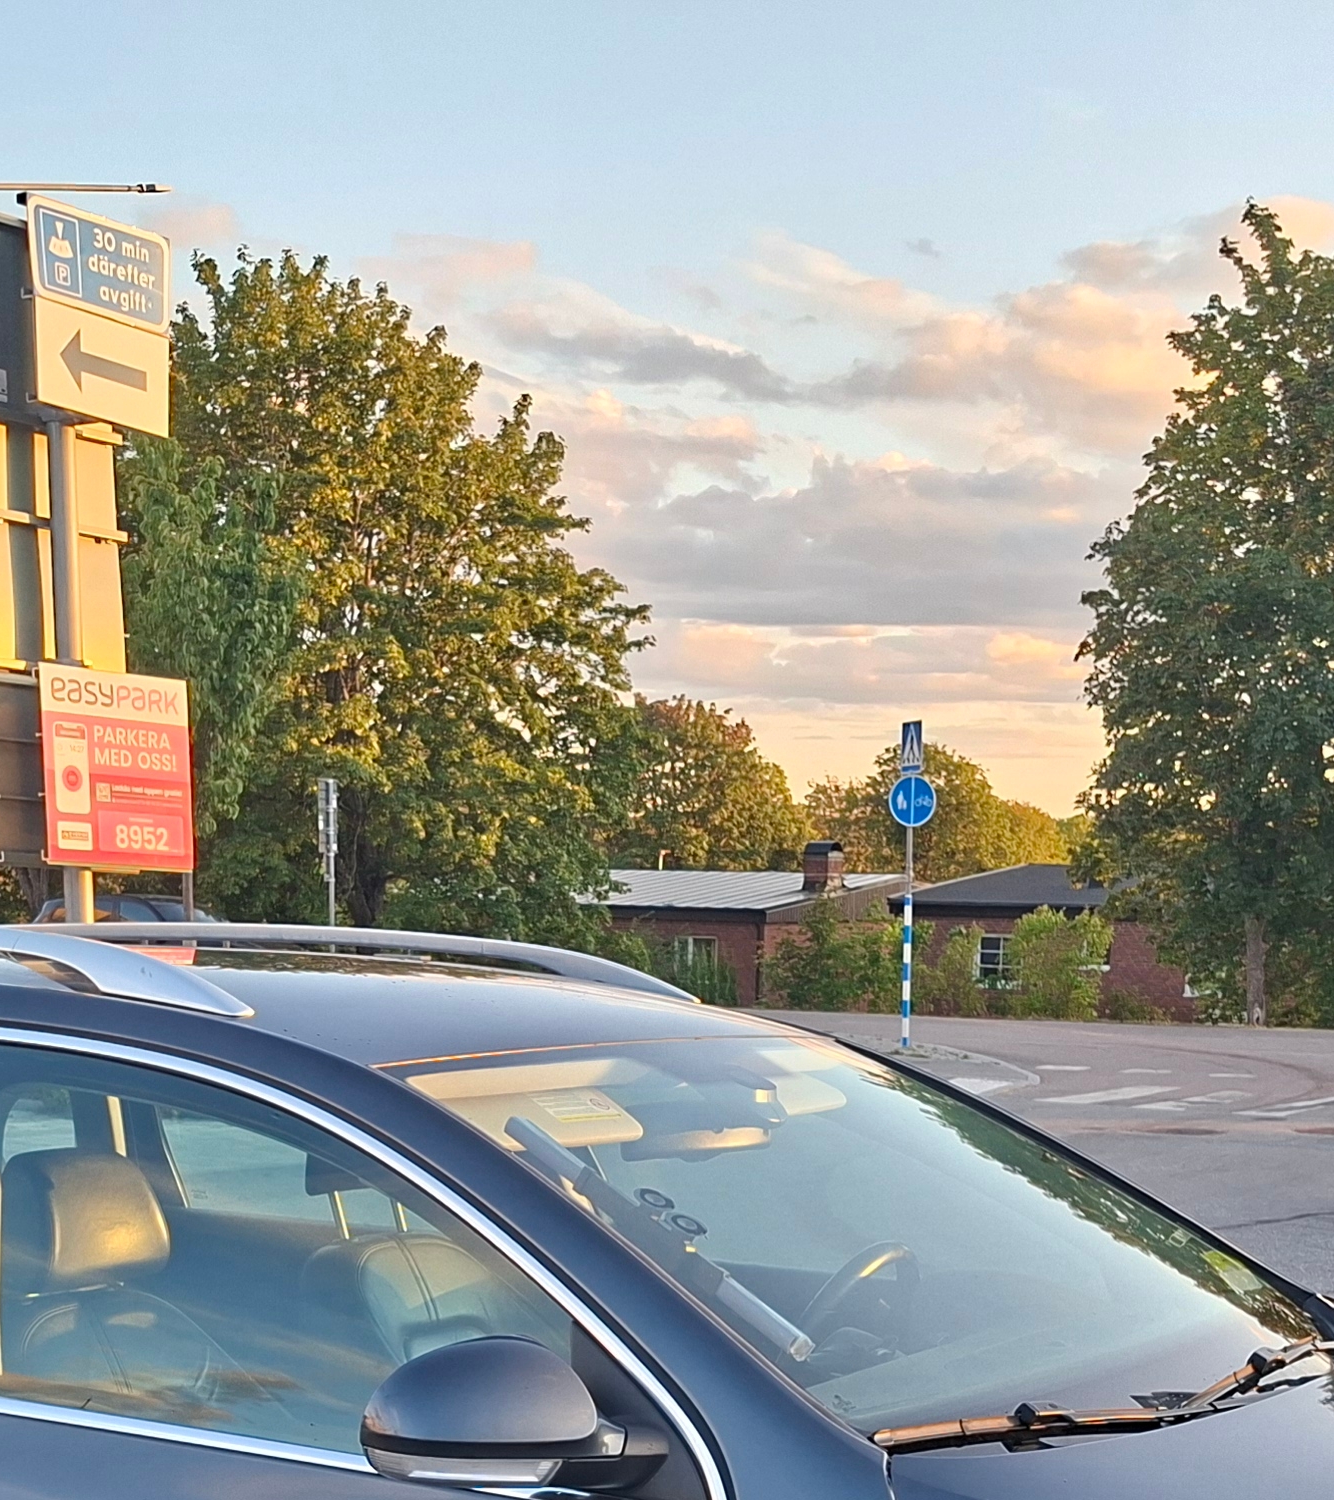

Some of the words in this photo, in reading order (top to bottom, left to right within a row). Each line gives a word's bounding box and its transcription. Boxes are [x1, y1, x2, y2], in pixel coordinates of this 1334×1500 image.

[93, 227, 116, 252] 30
[121, 240, 150, 263] min
[87, 253, 156, 290] därefter
[99, 285, 146, 313] avgift
[93, 725, 171, 750] PARKERA
[94, 748, 132, 767] MED
[137, 753, 177, 772] OSS!
[115, 824, 169, 851] 8952
